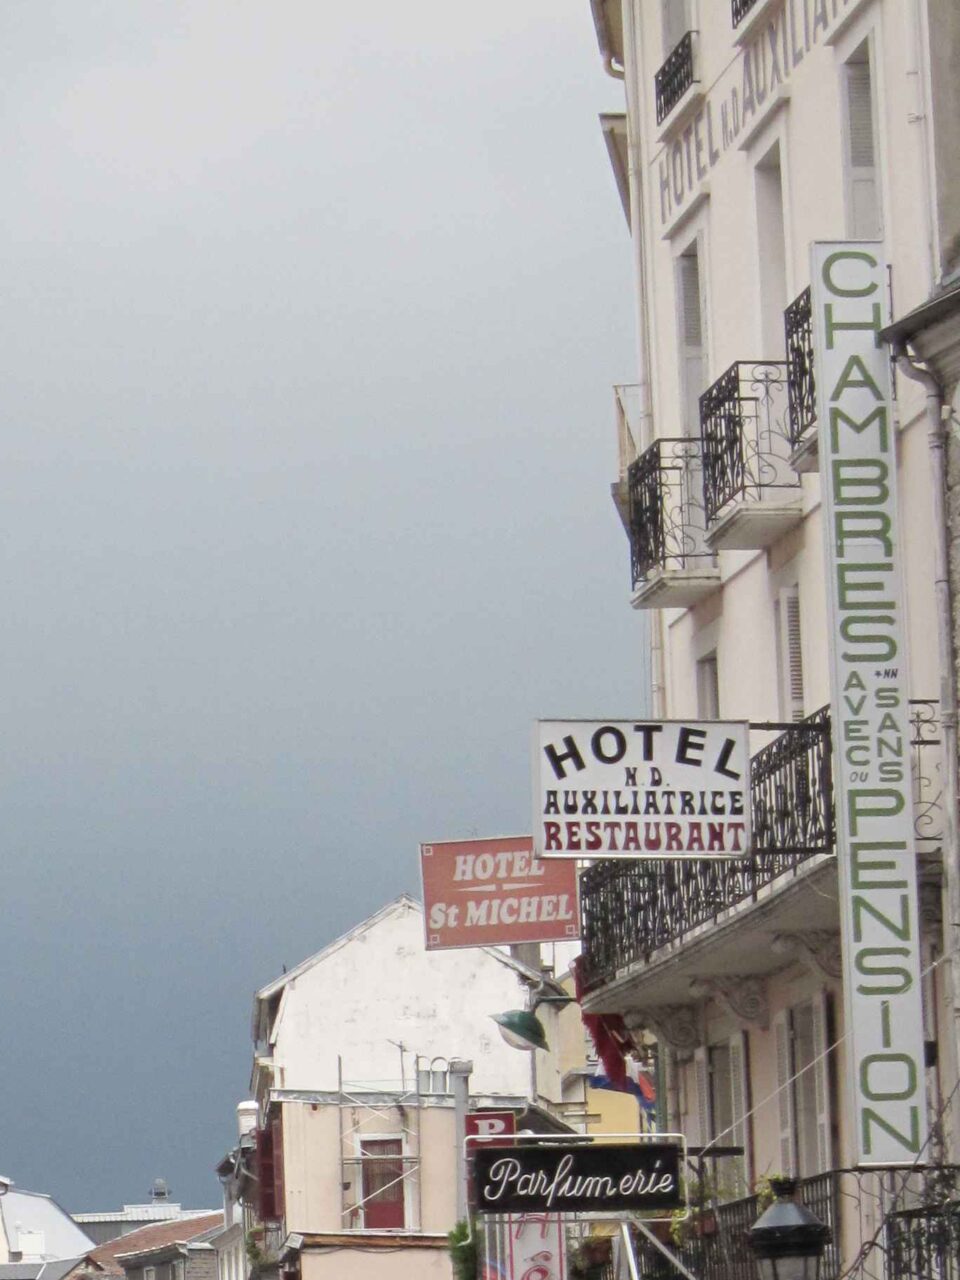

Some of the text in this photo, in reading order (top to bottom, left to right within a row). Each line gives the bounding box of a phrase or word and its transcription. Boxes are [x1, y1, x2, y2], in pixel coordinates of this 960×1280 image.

[659, 100, 720, 225] HOTEL
[822, 252, 898, 663] CHAMBRES
[844, 671, 870, 767] AVEC
[874, 688, 904, 783] SANS
[544, 725, 741, 780] HOTEL
[850, 772, 869, 783] OU
[544, 790, 744, 815] AUXILIATRICE
[544, 822, 745, 850] RESTAURANT
[453, 851, 544, 881] HOTEL
[430, 894, 572, 929] St MICHEL
[848, 789, 921, 1156] PENSION
[484, 1154, 674, 1207] Parfumerie
